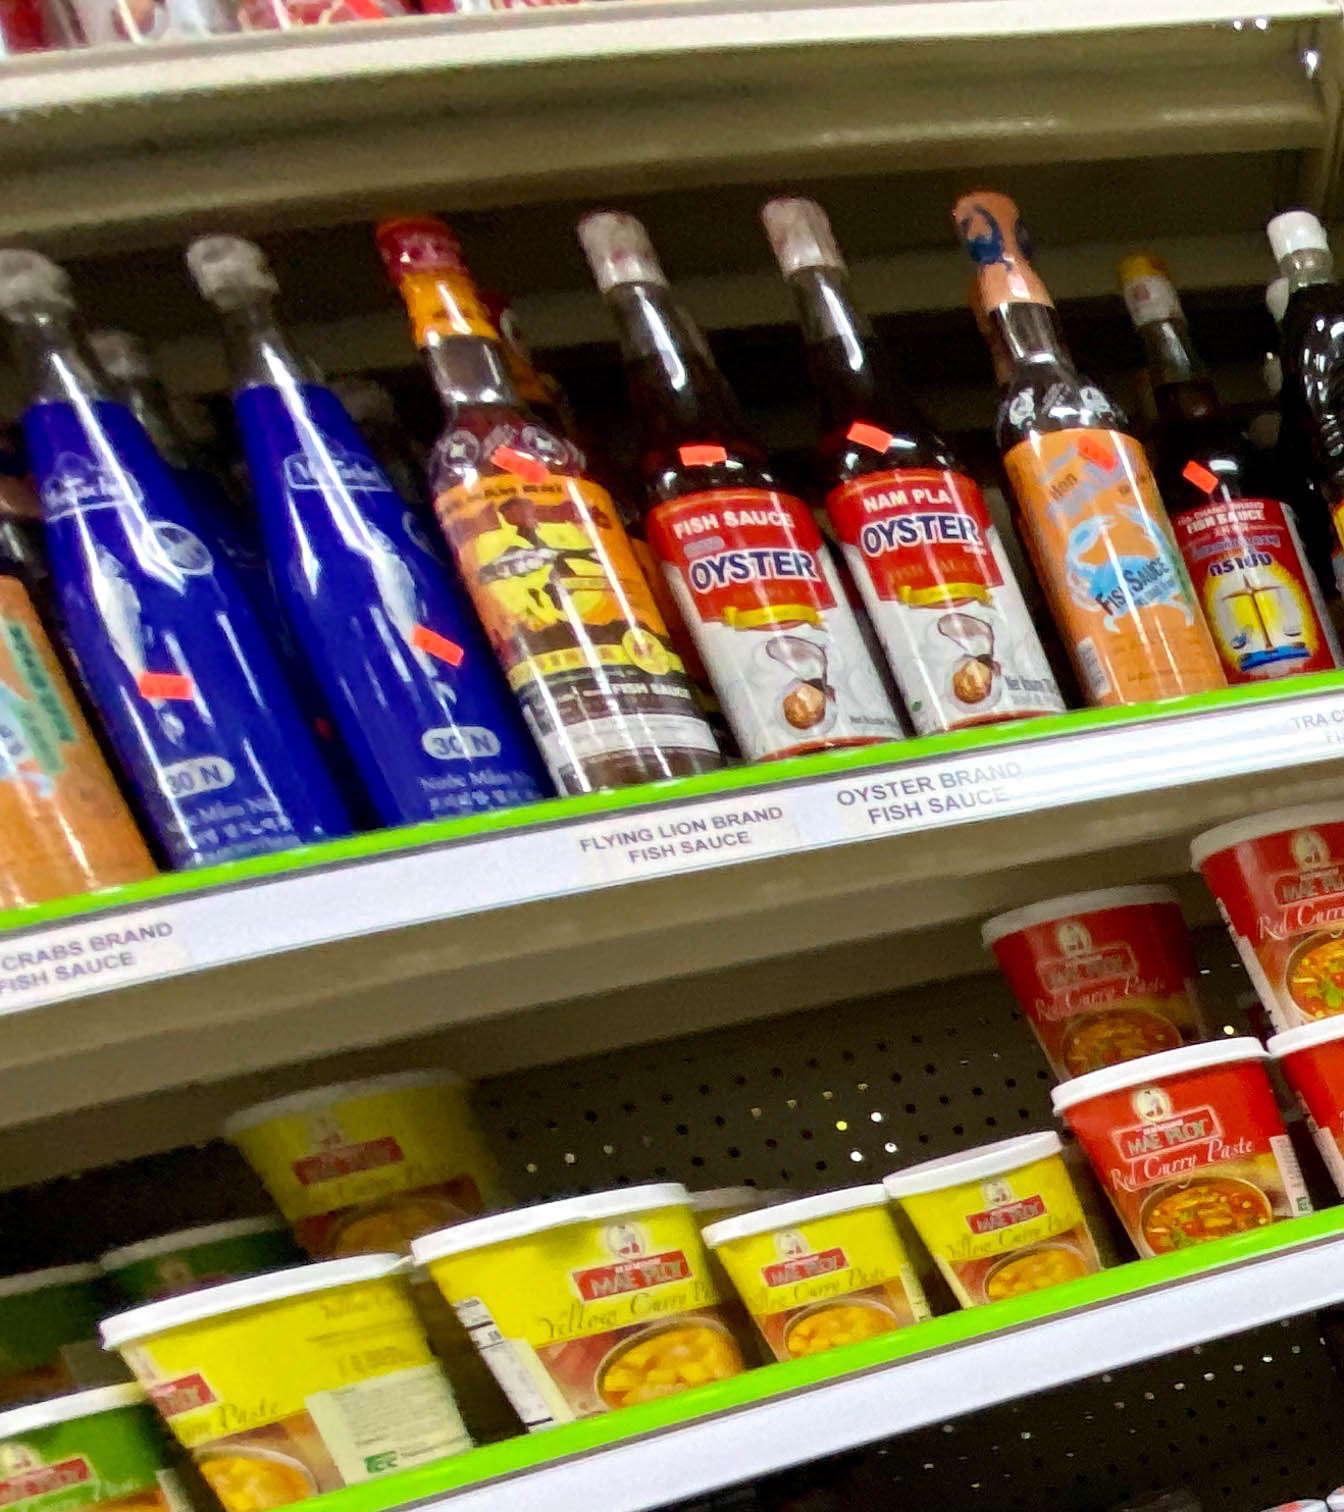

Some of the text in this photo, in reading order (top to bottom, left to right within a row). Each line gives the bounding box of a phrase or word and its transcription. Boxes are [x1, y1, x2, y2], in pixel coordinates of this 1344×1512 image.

[863, 487, 954, 513] NAM PLA
[673, 508, 794, 540] FISH SAUCE
[860, 512, 980, 558] OYSTER
[689, 549, 819, 594] OYSTER
[1291, 713, 1326, 731] TRA
[837, 761, 1022, 807] OYSTER BRAND
[867, 787, 1008, 825] FISH SAUCE
[579, 805, 784, 855] FLYING LION BRAND
[628, 831, 752, 864] FISH SAUCE
[2, 921, 174, 970] CRABS BRAND
[55, 950, 137, 982] SAUCE
[1110, 1138, 1254, 1193] Red Curry Paste
